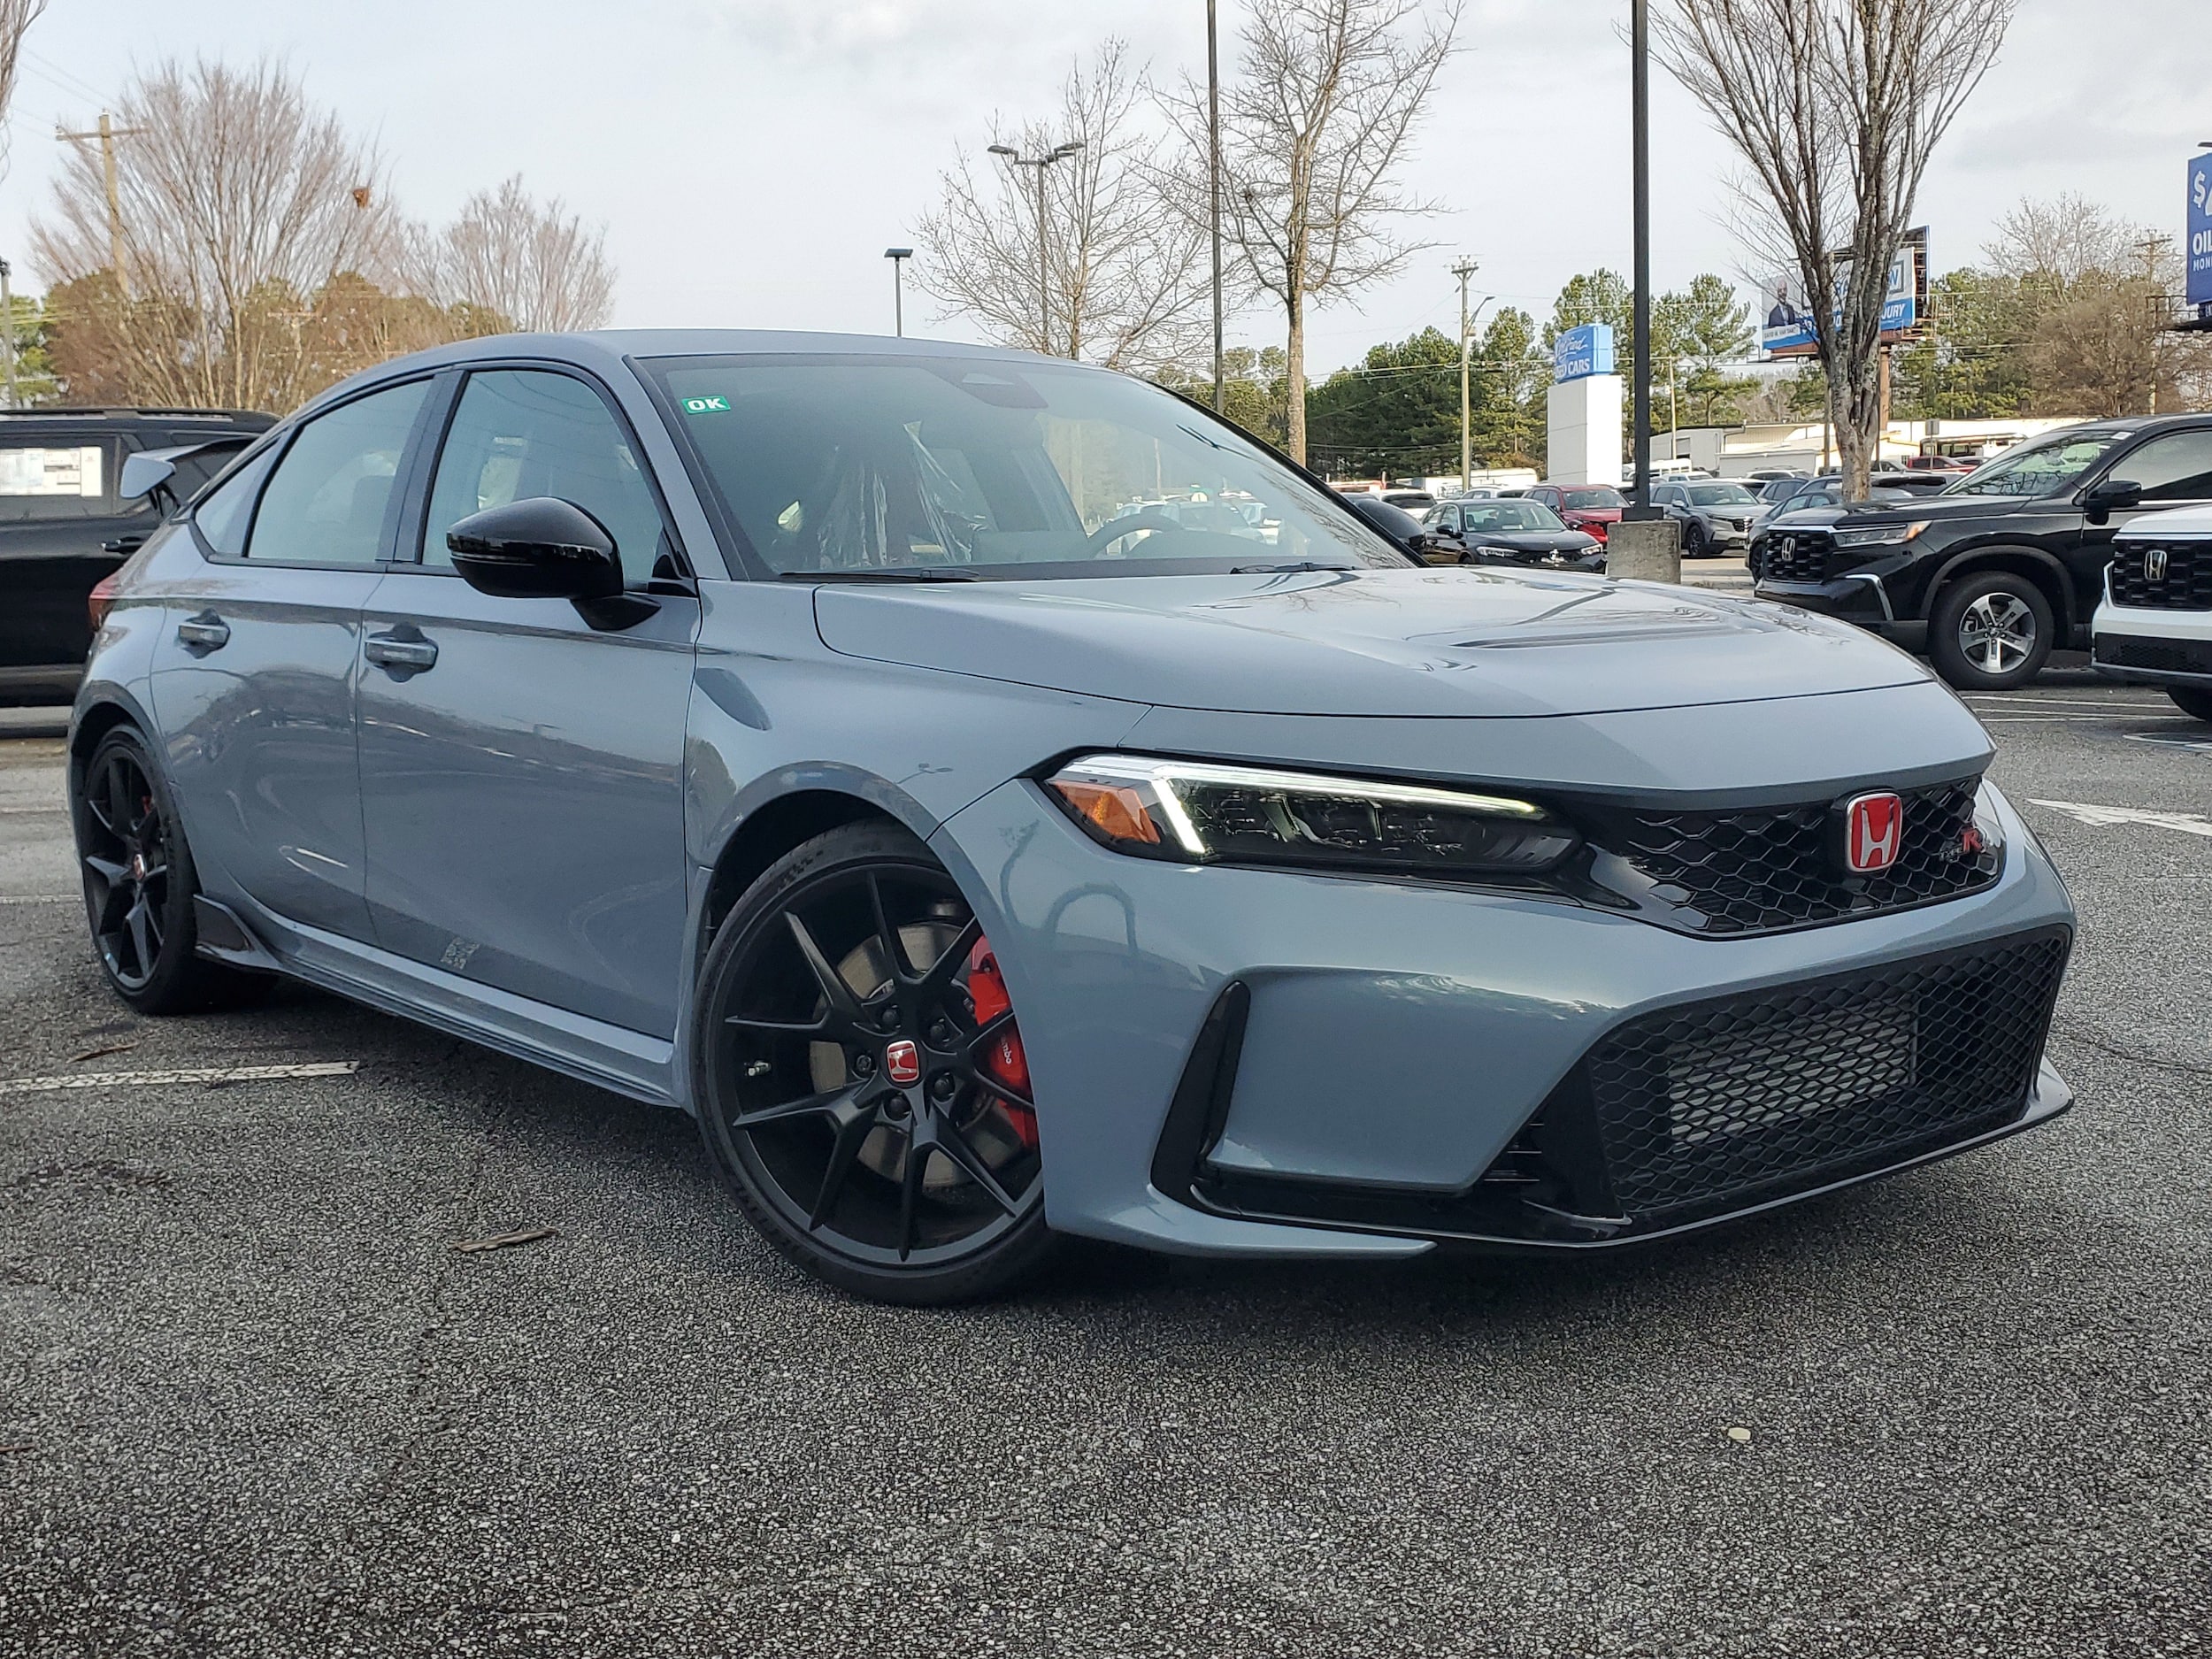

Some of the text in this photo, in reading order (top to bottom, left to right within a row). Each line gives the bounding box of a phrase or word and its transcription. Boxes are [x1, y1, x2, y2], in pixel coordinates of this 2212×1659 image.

[2193, 229, 2212, 256] OIL
[1568, 358, 1590, 376] CARS
[687, 398, 726, 411] OK
[1963, 828, 1983, 854] R
